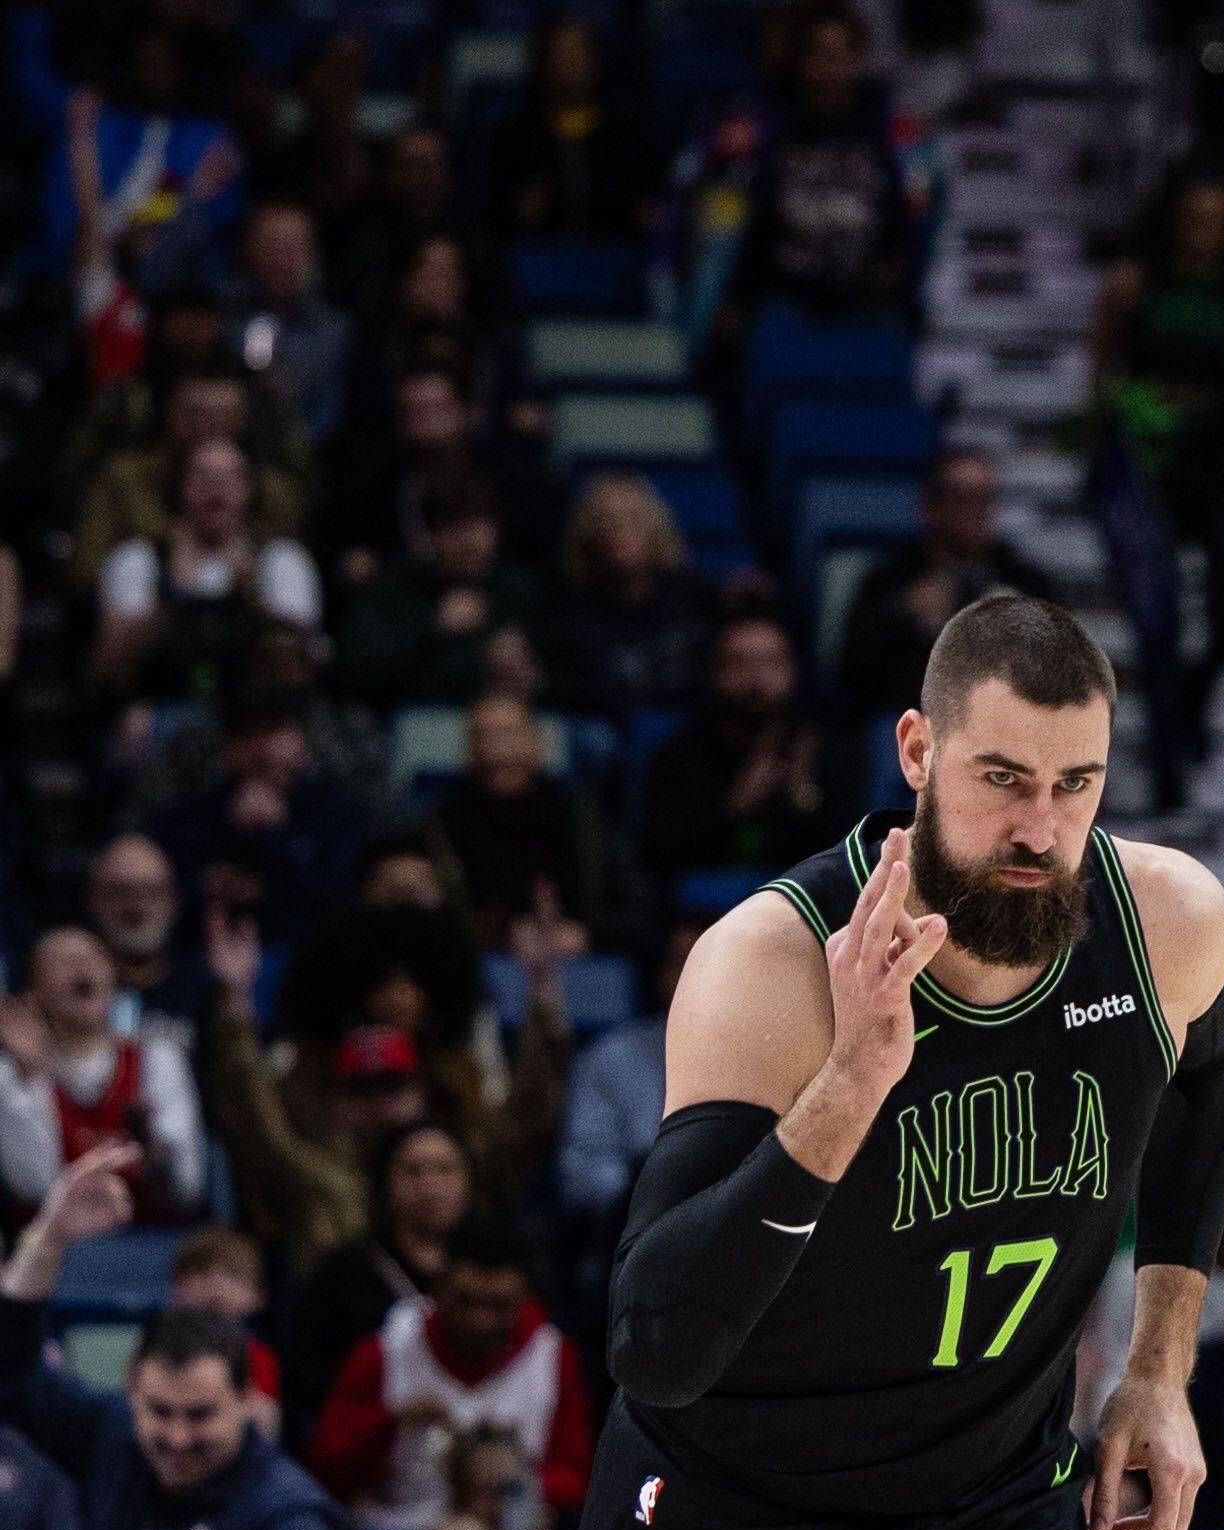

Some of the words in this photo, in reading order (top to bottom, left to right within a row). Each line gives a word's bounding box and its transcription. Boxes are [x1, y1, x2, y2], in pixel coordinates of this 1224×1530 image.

[1063, 994, 1136, 1029] ibotta
[892, 1070, 1109, 1231] NOLA
[932, 1237, 1058, 1367] 17
